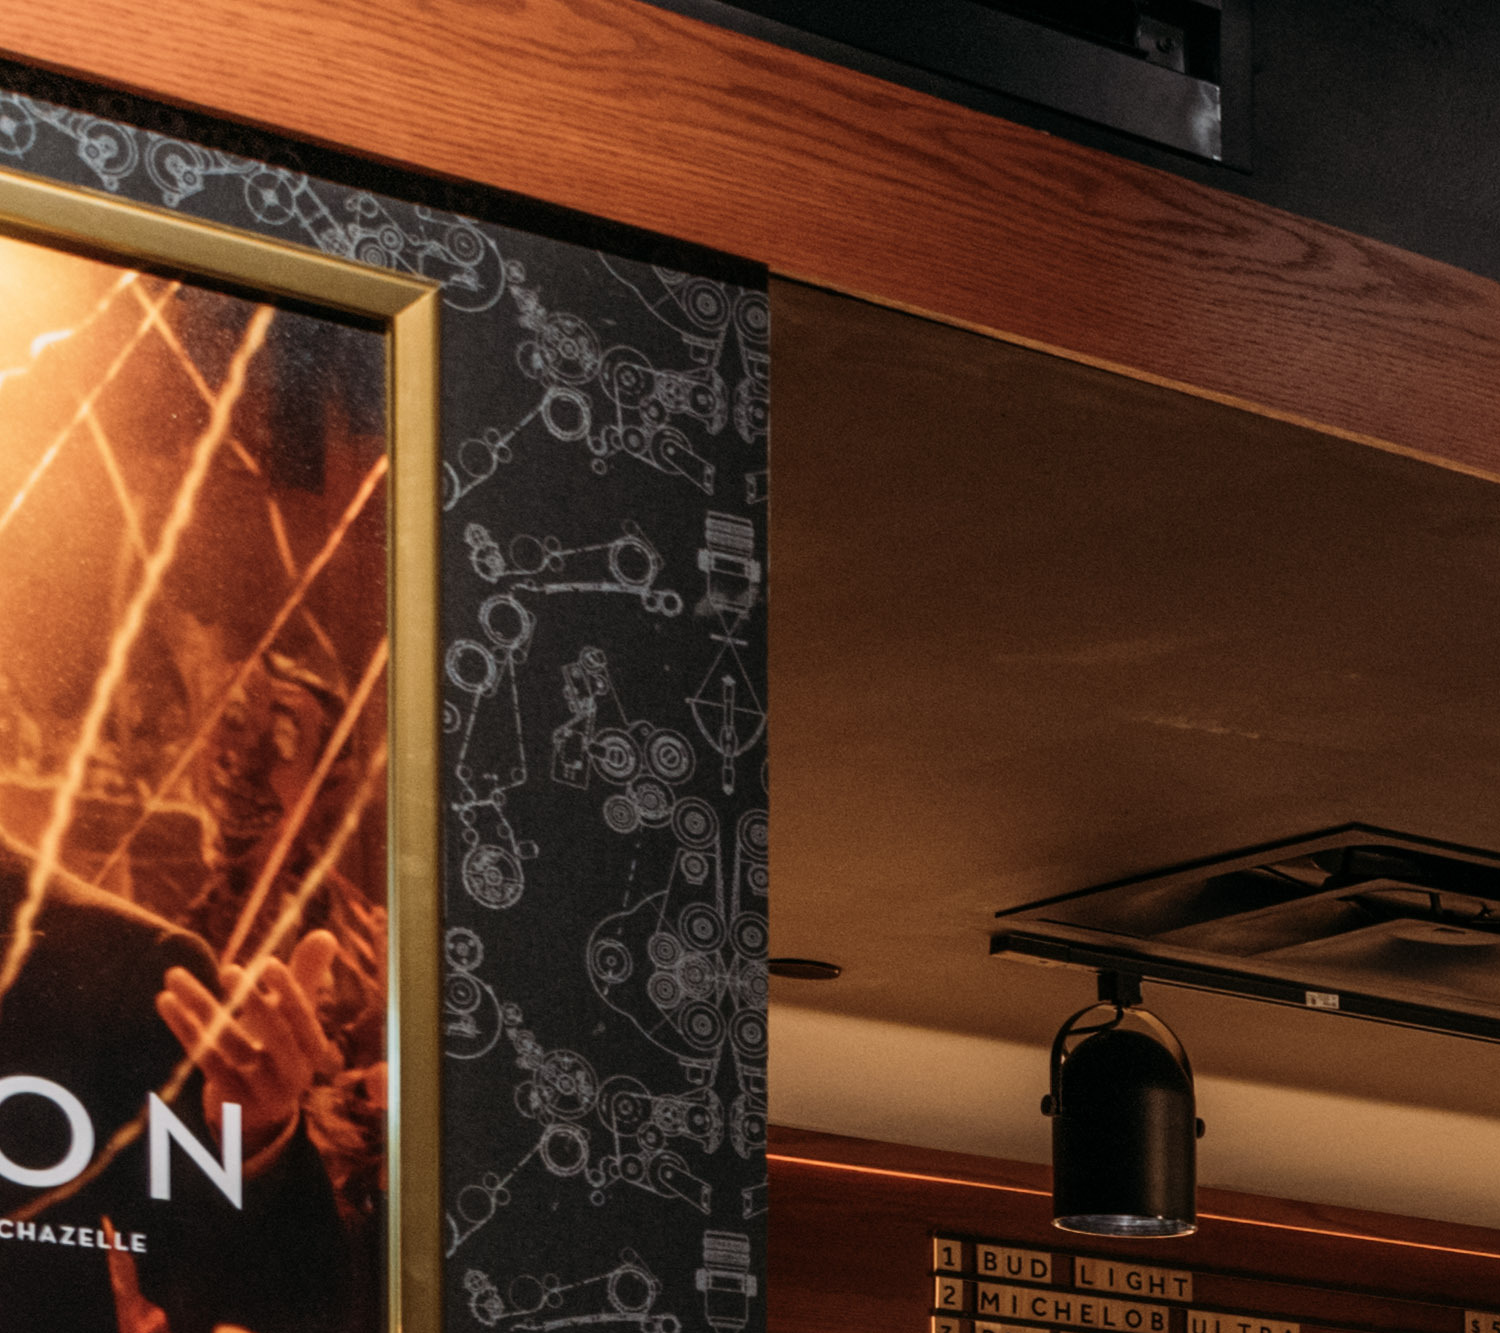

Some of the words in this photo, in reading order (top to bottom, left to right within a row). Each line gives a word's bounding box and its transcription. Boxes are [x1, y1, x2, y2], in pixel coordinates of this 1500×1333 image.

[0, 1218, 147, 1253] CHAZELLE
[944, 1247, 956, 1267] 1
[983, 1251, 1048, 1279] BUD
[1079, 1264, 1188, 1297] LIGHT
[943, 1285, 956, 1306] 2
[979, 1291, 1164, 1331] MICHELOB
